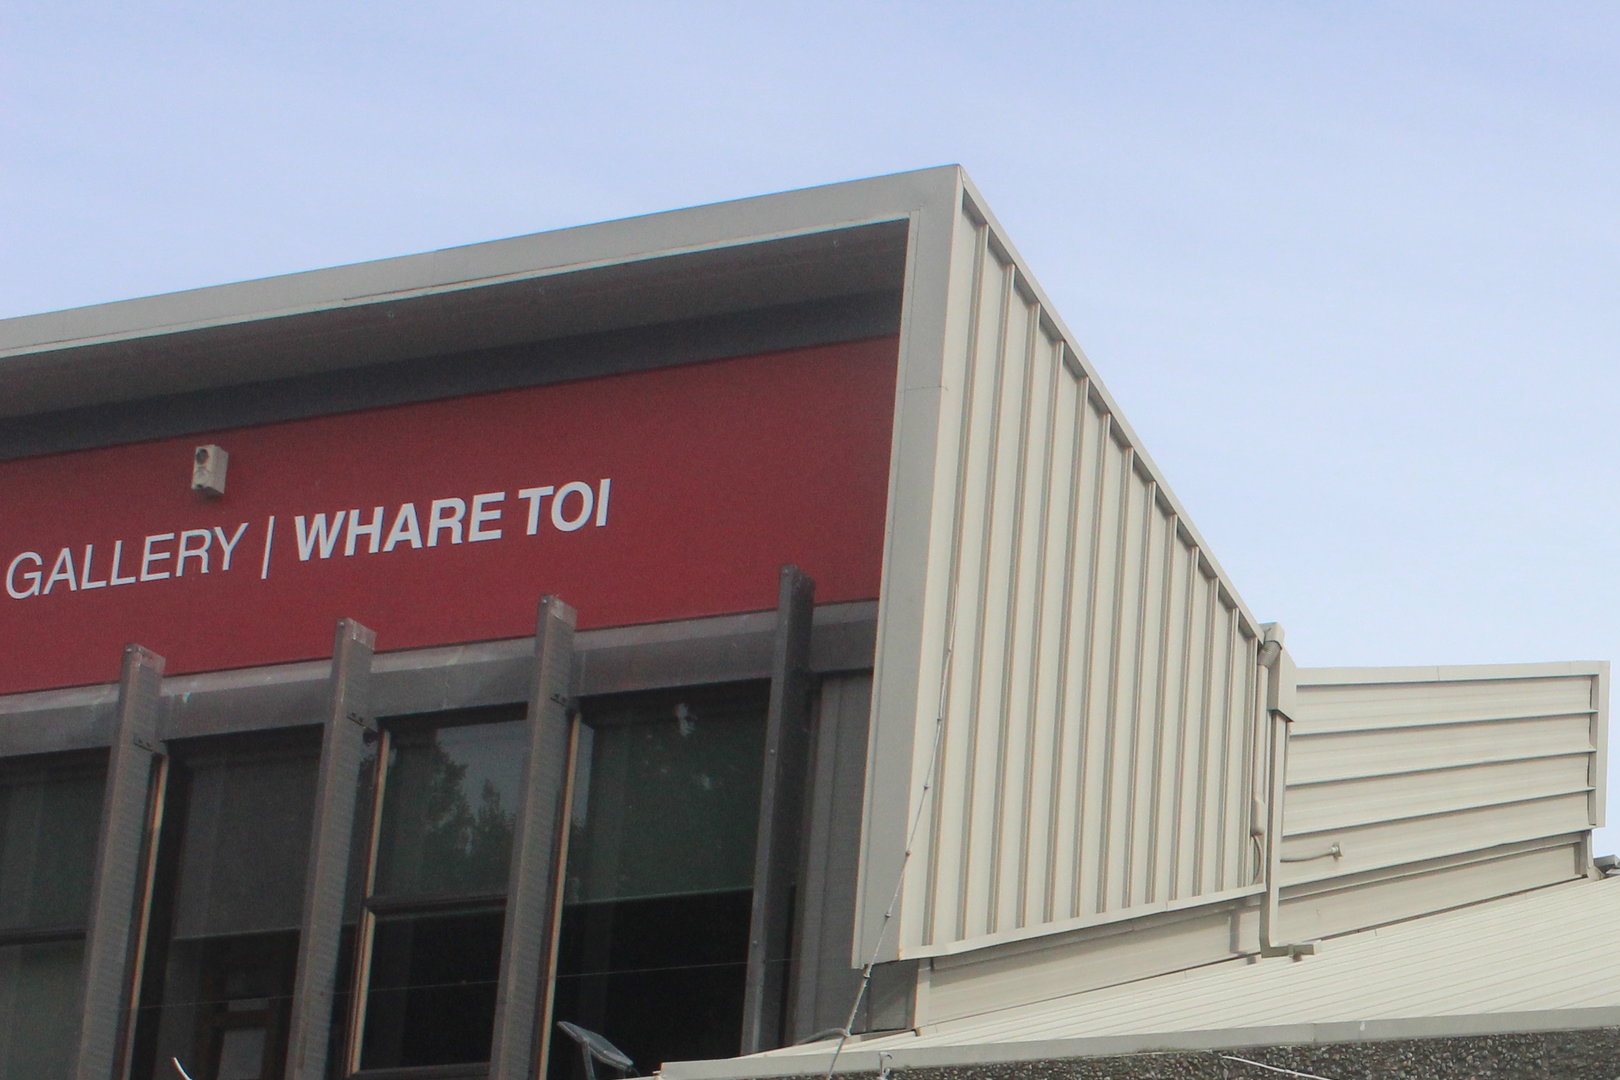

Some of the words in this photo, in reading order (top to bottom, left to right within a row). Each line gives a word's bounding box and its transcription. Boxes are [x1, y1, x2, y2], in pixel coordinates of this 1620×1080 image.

[295, 492, 505, 562] WHARE
[517, 478, 611, 536] TOI
[5, 522, 249, 600] GALLERY
